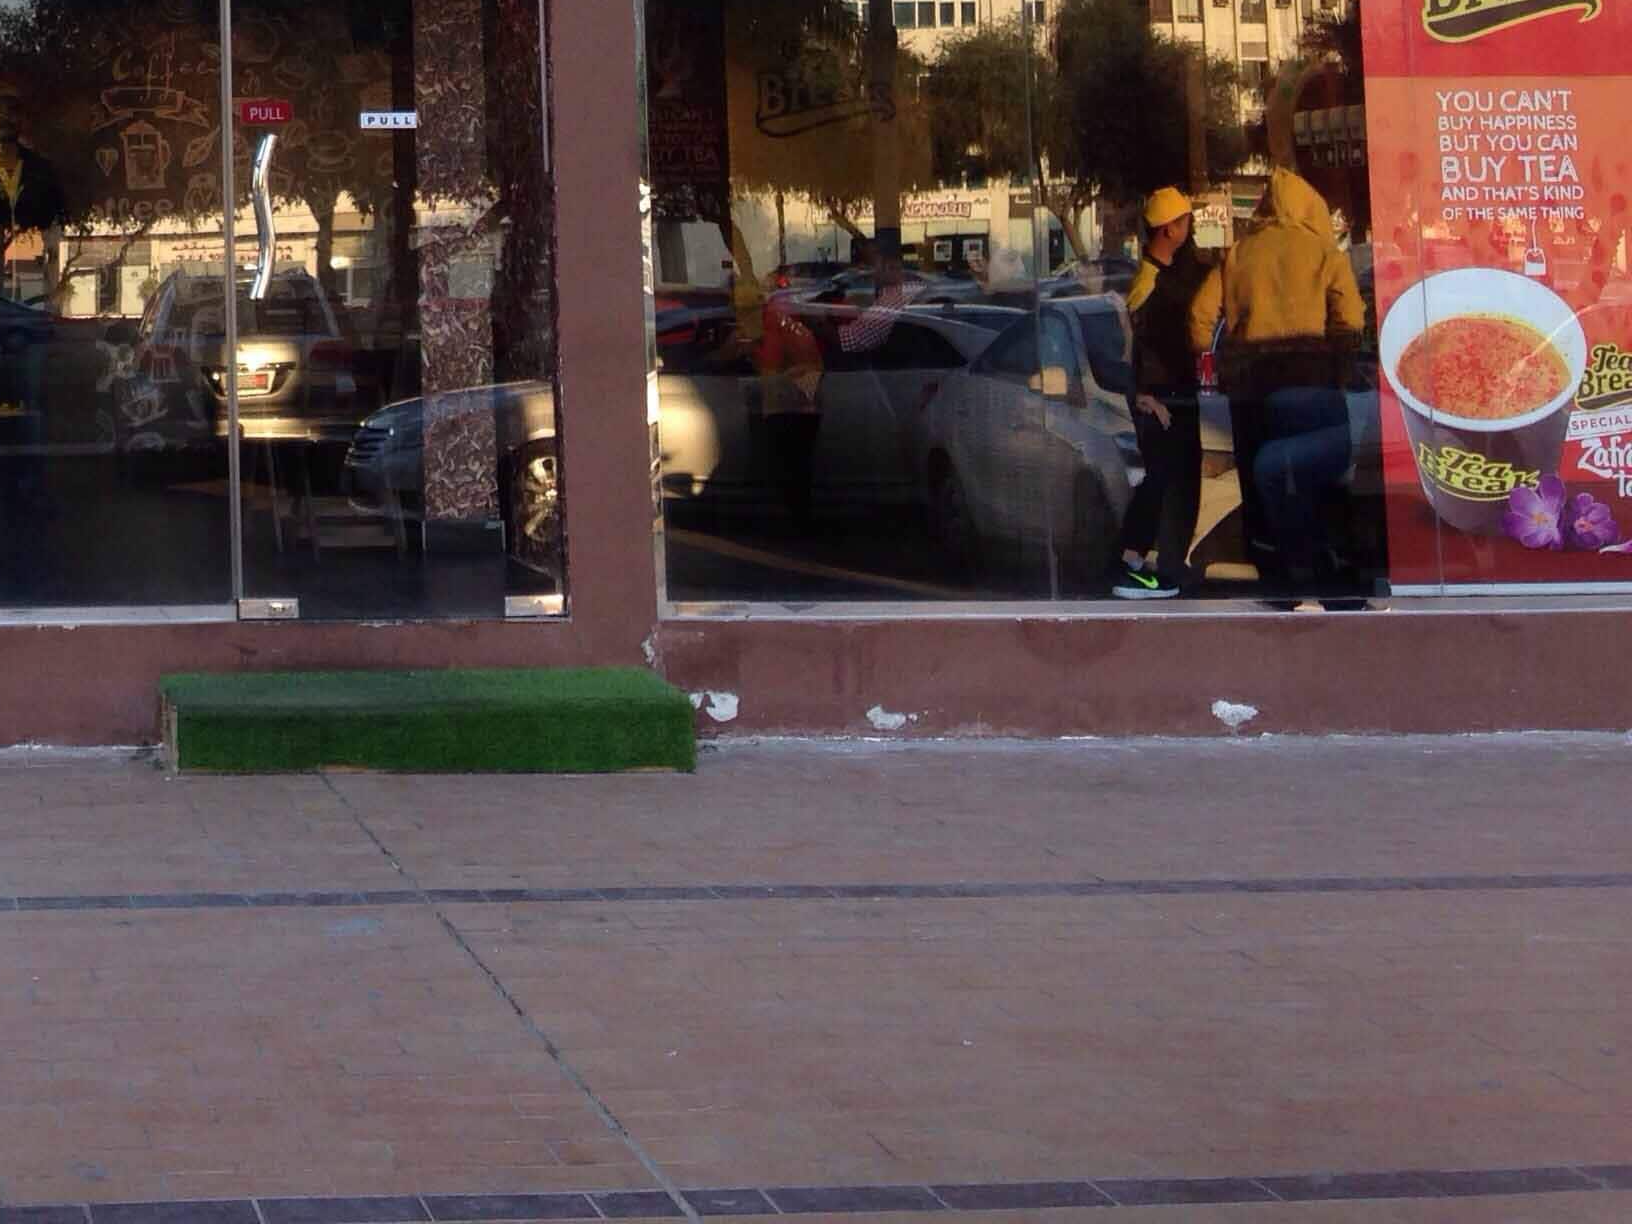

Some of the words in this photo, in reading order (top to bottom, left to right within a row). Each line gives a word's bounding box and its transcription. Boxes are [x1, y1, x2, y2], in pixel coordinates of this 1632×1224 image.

[1436, 89, 1494, 113] YOU
[1499, 89, 1573, 112] CAN'T
[249, 106, 285, 121] PULL
[367, 115, 412, 126] PULL
[1438, 115, 1475, 131] BUY
[1479, 115, 1578, 131] HAPPINESS
[1439, 134, 1480, 152] BUT
[1486, 134, 1532, 152] YOU
[1537, 134, 1579, 152] CAN
[1441, 155, 1507, 184] BUY
[1517, 154, 1580, 183] TEA
[1441, 187, 1479, 201] AND
[1482, 186, 1540, 201] THAT'S
[1543, 186, 1585, 201] KIND
[1442, 208, 1464, 221] OF
[1466, 207, 1496, 220] THE
[1497, 207, 1538, 221] SAME
[1540, 206, 1585, 220] THING
[1578, 369, 1632, 399] Brea
[1571, 415, 1632, 431] SPECIAL
[1446, 448, 1507, 479] Tea
